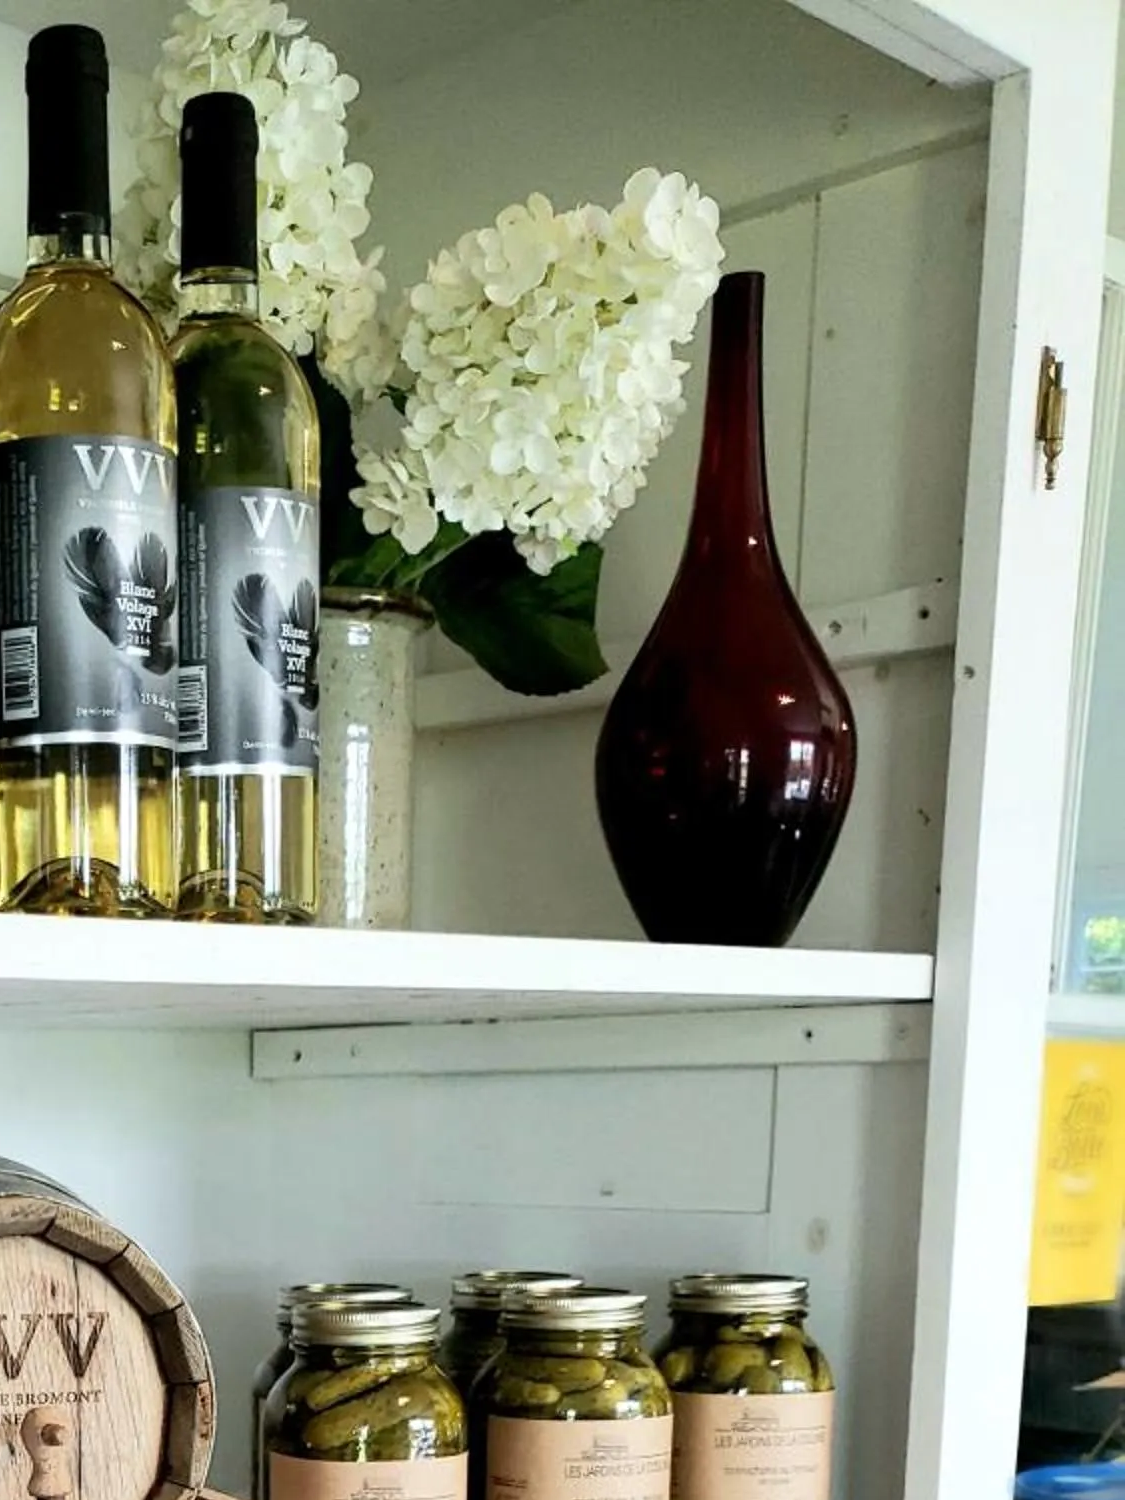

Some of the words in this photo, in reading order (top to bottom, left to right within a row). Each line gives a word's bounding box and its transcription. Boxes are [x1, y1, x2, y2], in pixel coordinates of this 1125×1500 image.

[241, 496, 314, 542] VV
[120, 580, 156, 599] Blanc
[115, 597, 159, 619] Volage
[126, 616, 152, 633] XVI
[281, 623, 309, 640] Blanc
[286, 657, 307, 674] XVI
[13, 1389, 103, 1406] BROMONT
